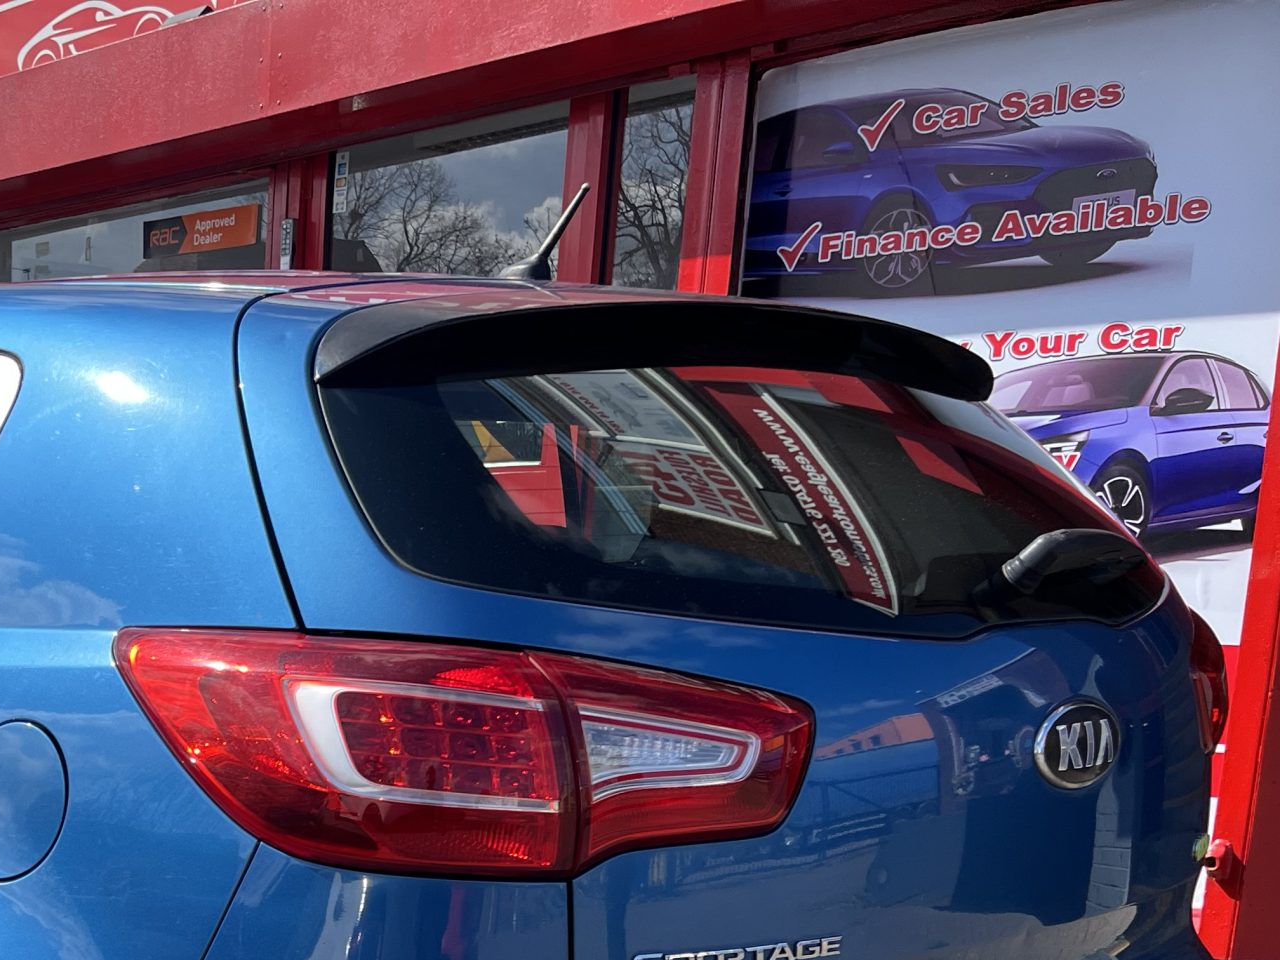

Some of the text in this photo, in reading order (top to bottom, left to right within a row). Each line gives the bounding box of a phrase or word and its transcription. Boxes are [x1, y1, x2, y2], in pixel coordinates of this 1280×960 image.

[912, 80, 1126, 136] Car Sales
[192, 231, 223, 246] Dealer
[193, 213, 236, 232] Approved
[817, 192, 1212, 263] Finance Available
[984, 322, 1185, 361] Your Car
[1055, 718, 1115, 772] KIA
